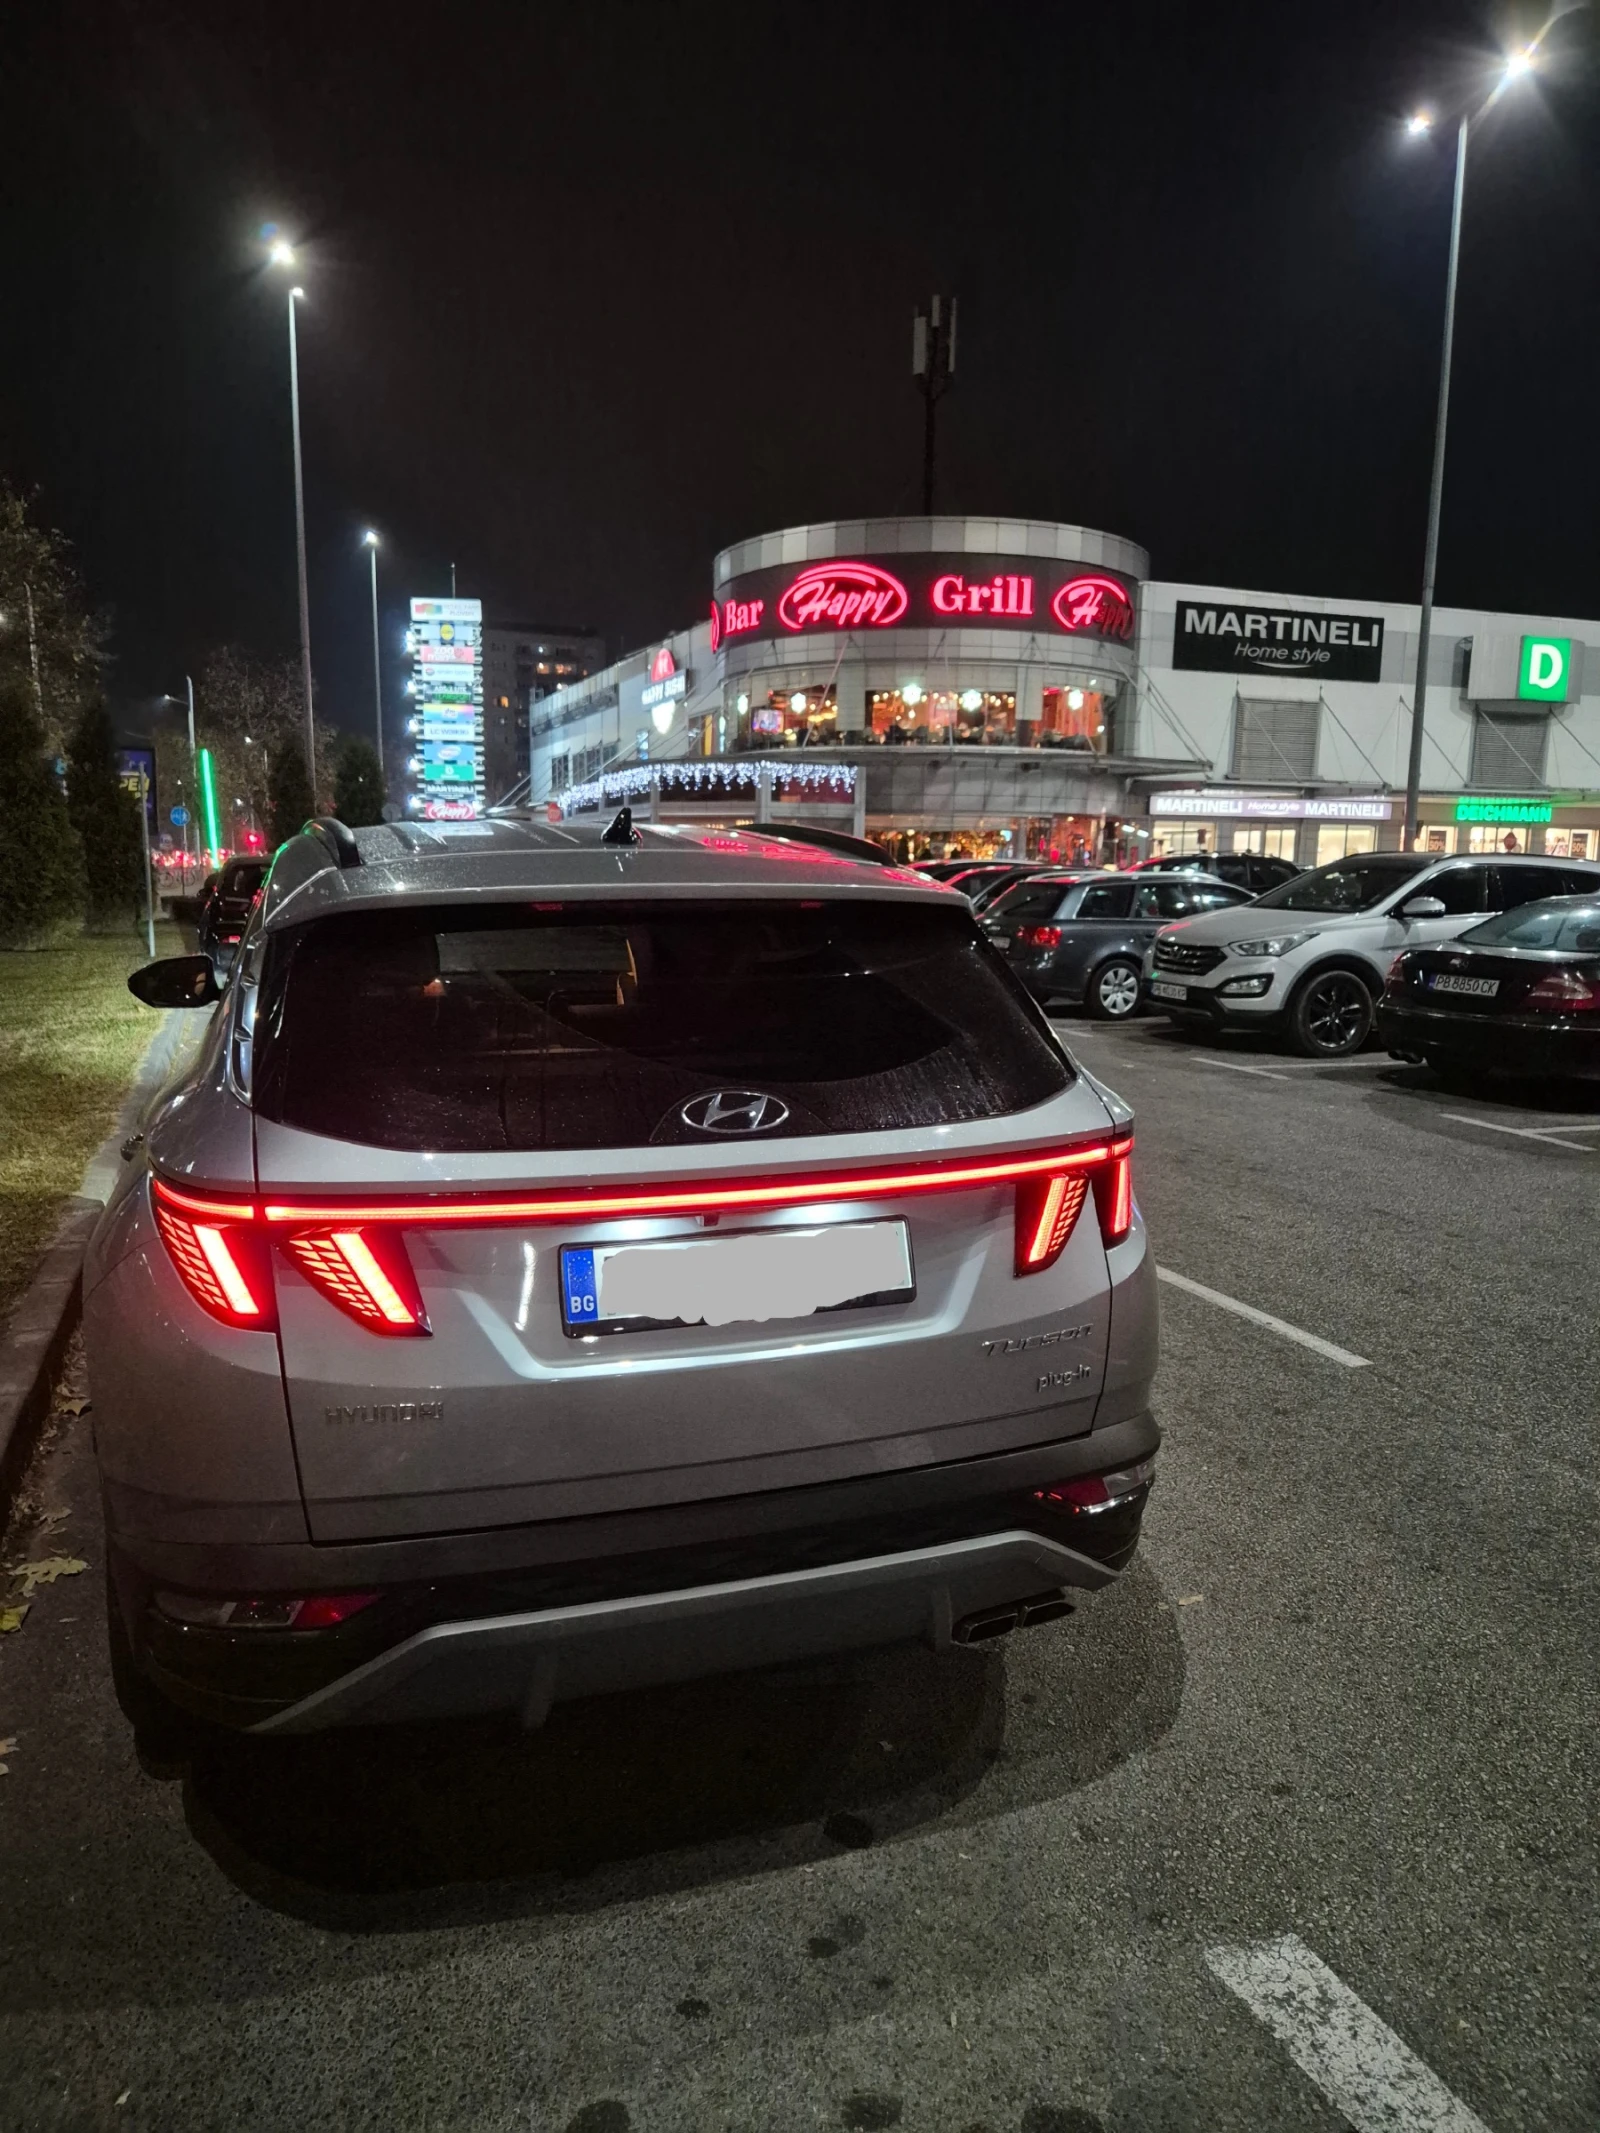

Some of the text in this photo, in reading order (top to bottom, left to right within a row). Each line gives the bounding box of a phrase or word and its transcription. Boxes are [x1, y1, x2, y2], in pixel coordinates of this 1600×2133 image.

[792, 580, 895, 626] Happy
[932, 575, 1034, 615] Grill
[724, 600, 764, 634] Bar
[1067, 585, 1132, 641] Happy
[1184, 608, 1380, 647] MARTINELI
[1234, 642, 1332, 664] Home style
[1528, 643, 1563, 689] D
[426, 785, 475, 793] MARTINELI
[1156, 798, 1385, 817] MARTINELI Home style MARTINELI
[1457, 804, 1553, 823] DEICHMANN
[1452, 977, 1480, 992] 8850
[1480, 980, 1497, 994] CK
[571, 1294, 595, 1314] BG
[325, 1402, 444, 1424] HYUNDAI
